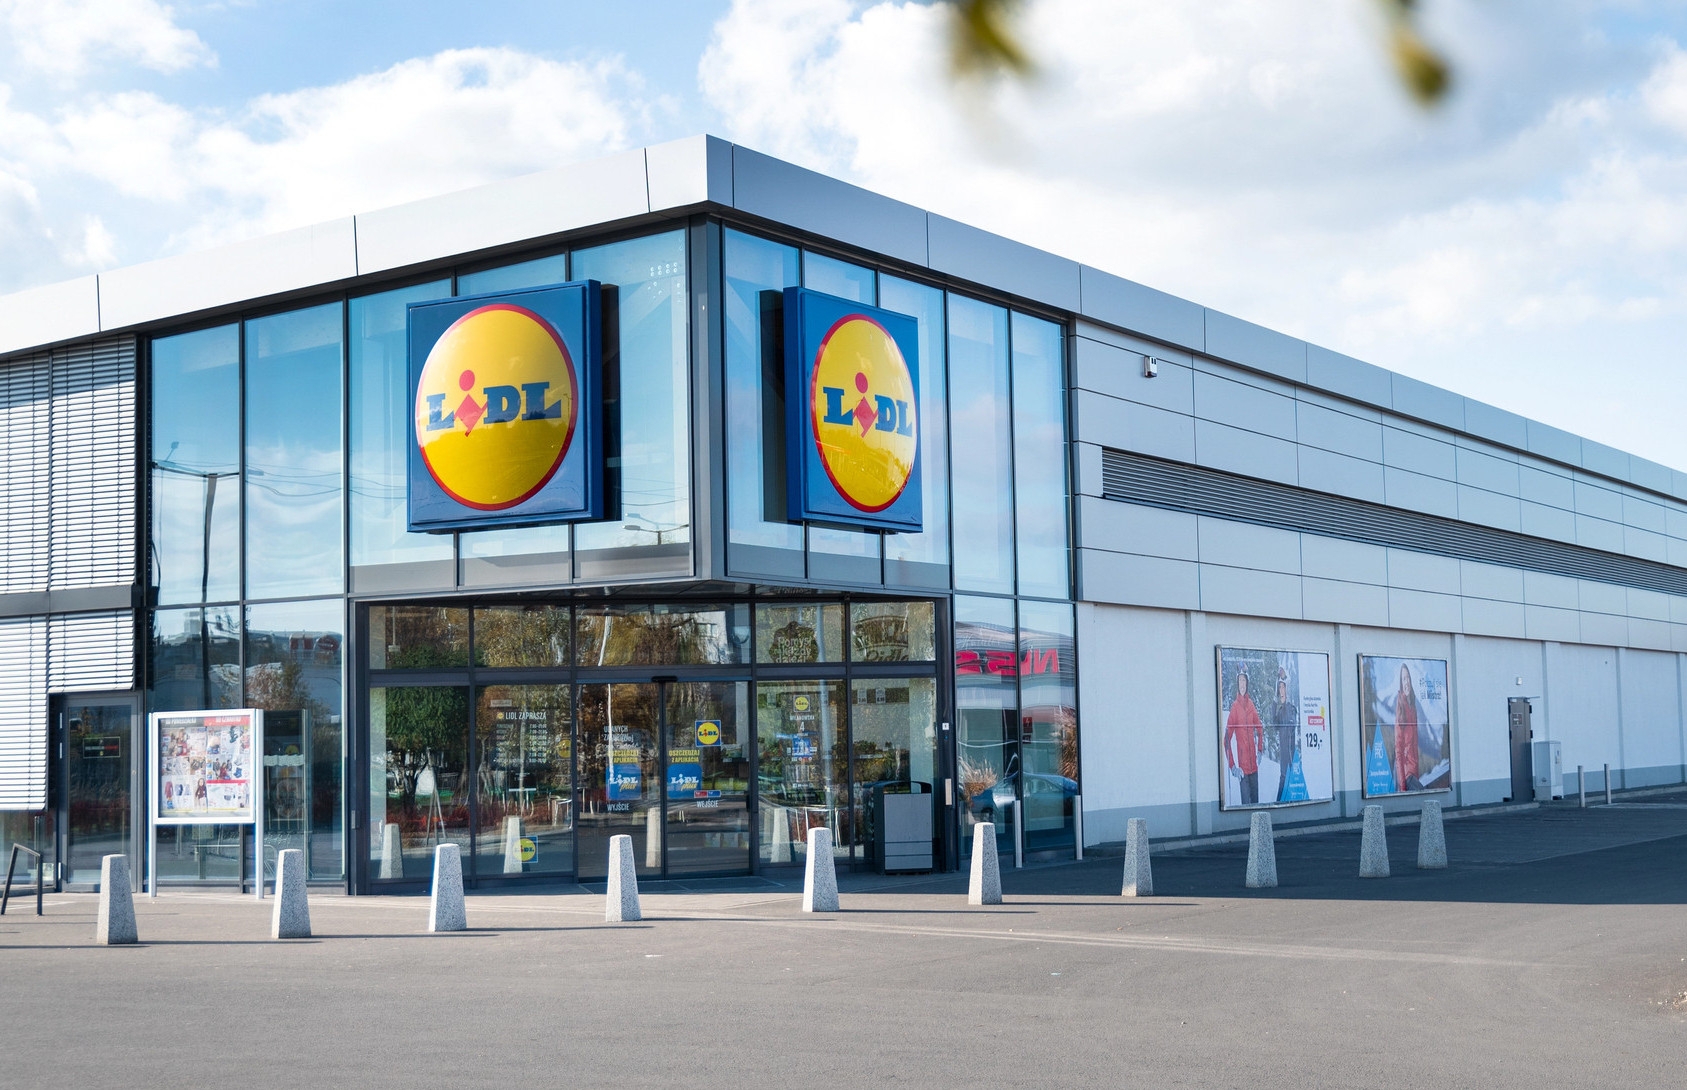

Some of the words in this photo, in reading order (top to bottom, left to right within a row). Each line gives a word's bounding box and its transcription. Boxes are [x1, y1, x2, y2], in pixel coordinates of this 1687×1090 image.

[505, 711, 518, 720] LIDL
[519, 711, 547, 720] ZAPRASZA
[799, 721, 805, 732] 4
[606, 801, 630, 811] WYJŚCIE
[696, 798, 719, 808] WEJŚCIE
